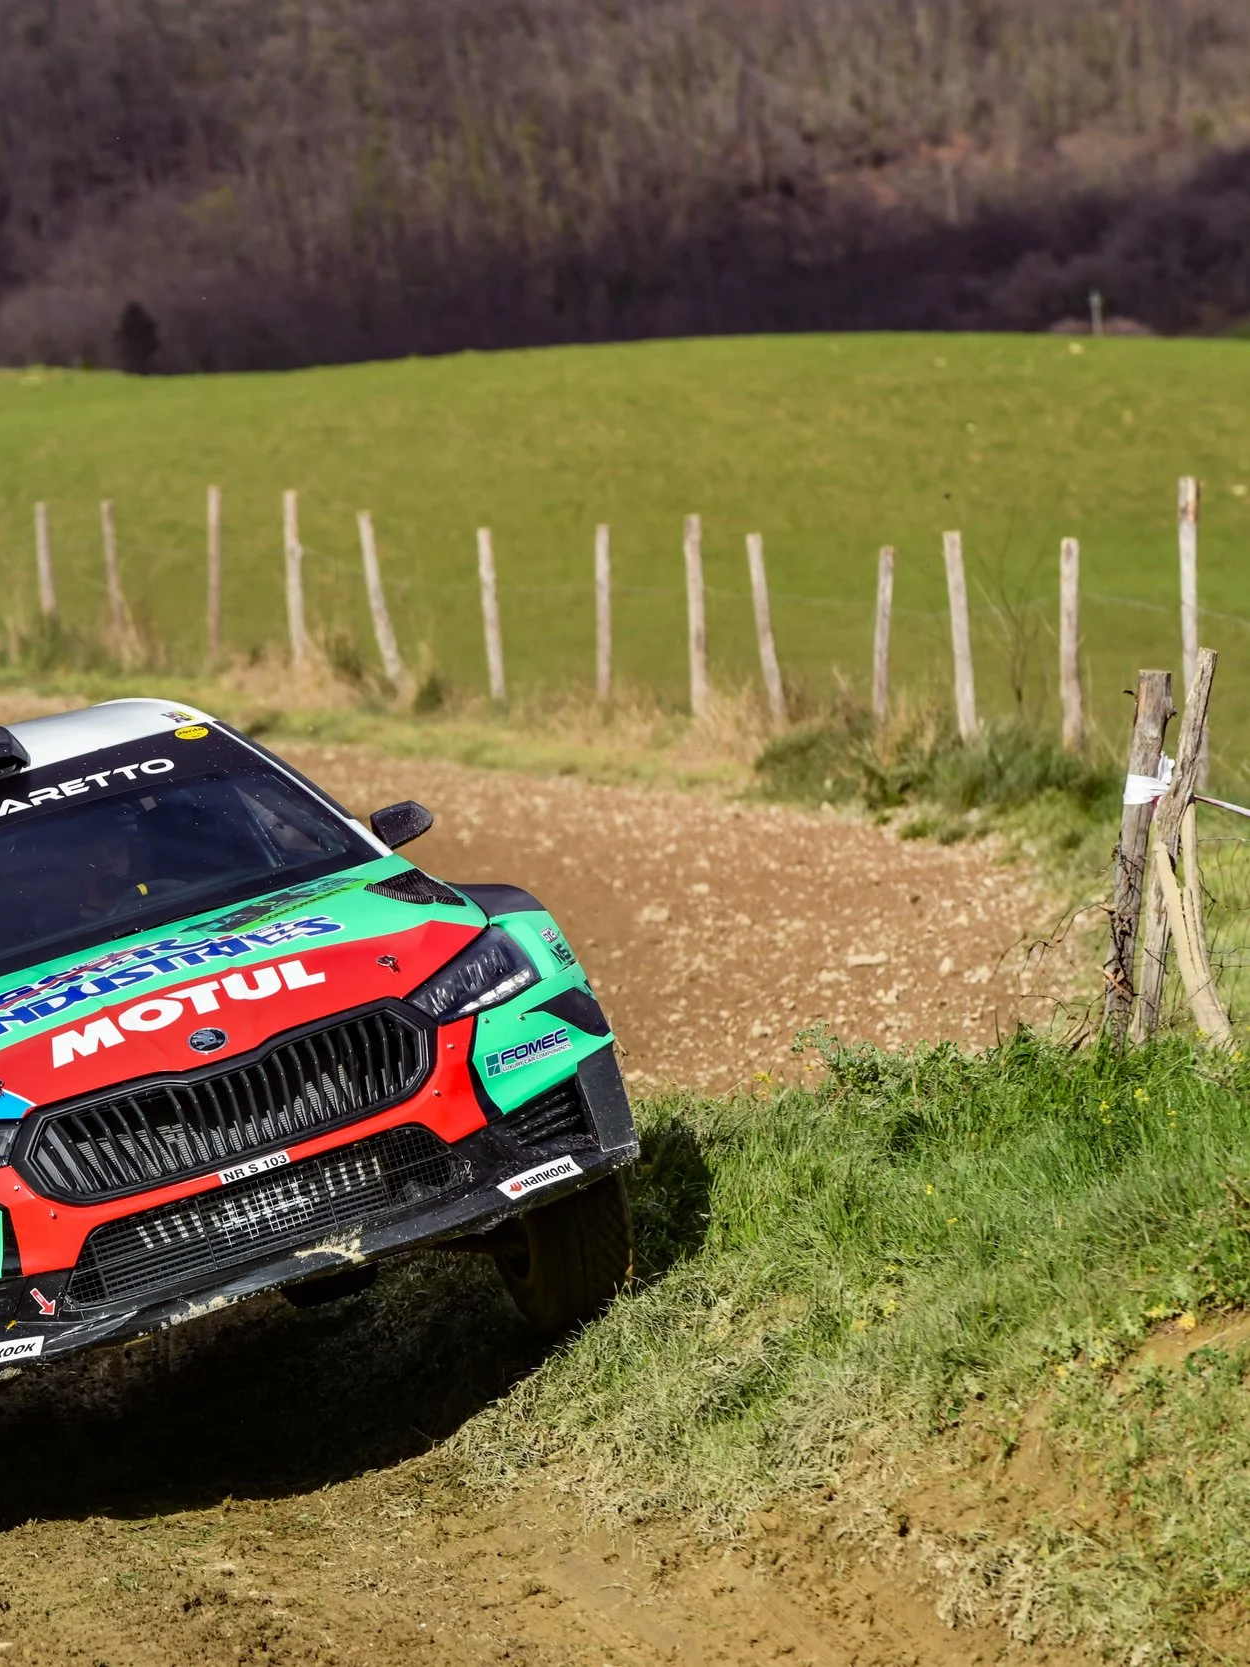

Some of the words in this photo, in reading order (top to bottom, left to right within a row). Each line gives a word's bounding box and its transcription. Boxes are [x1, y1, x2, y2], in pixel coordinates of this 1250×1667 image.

[51, 960, 327, 1069] MOTUL
[501, 1028, 569, 1064] FOMEC
[223, 1167, 247, 1183] NR
[248, 1162, 260, 1174] S
[264, 1154, 288, 1169] 103
